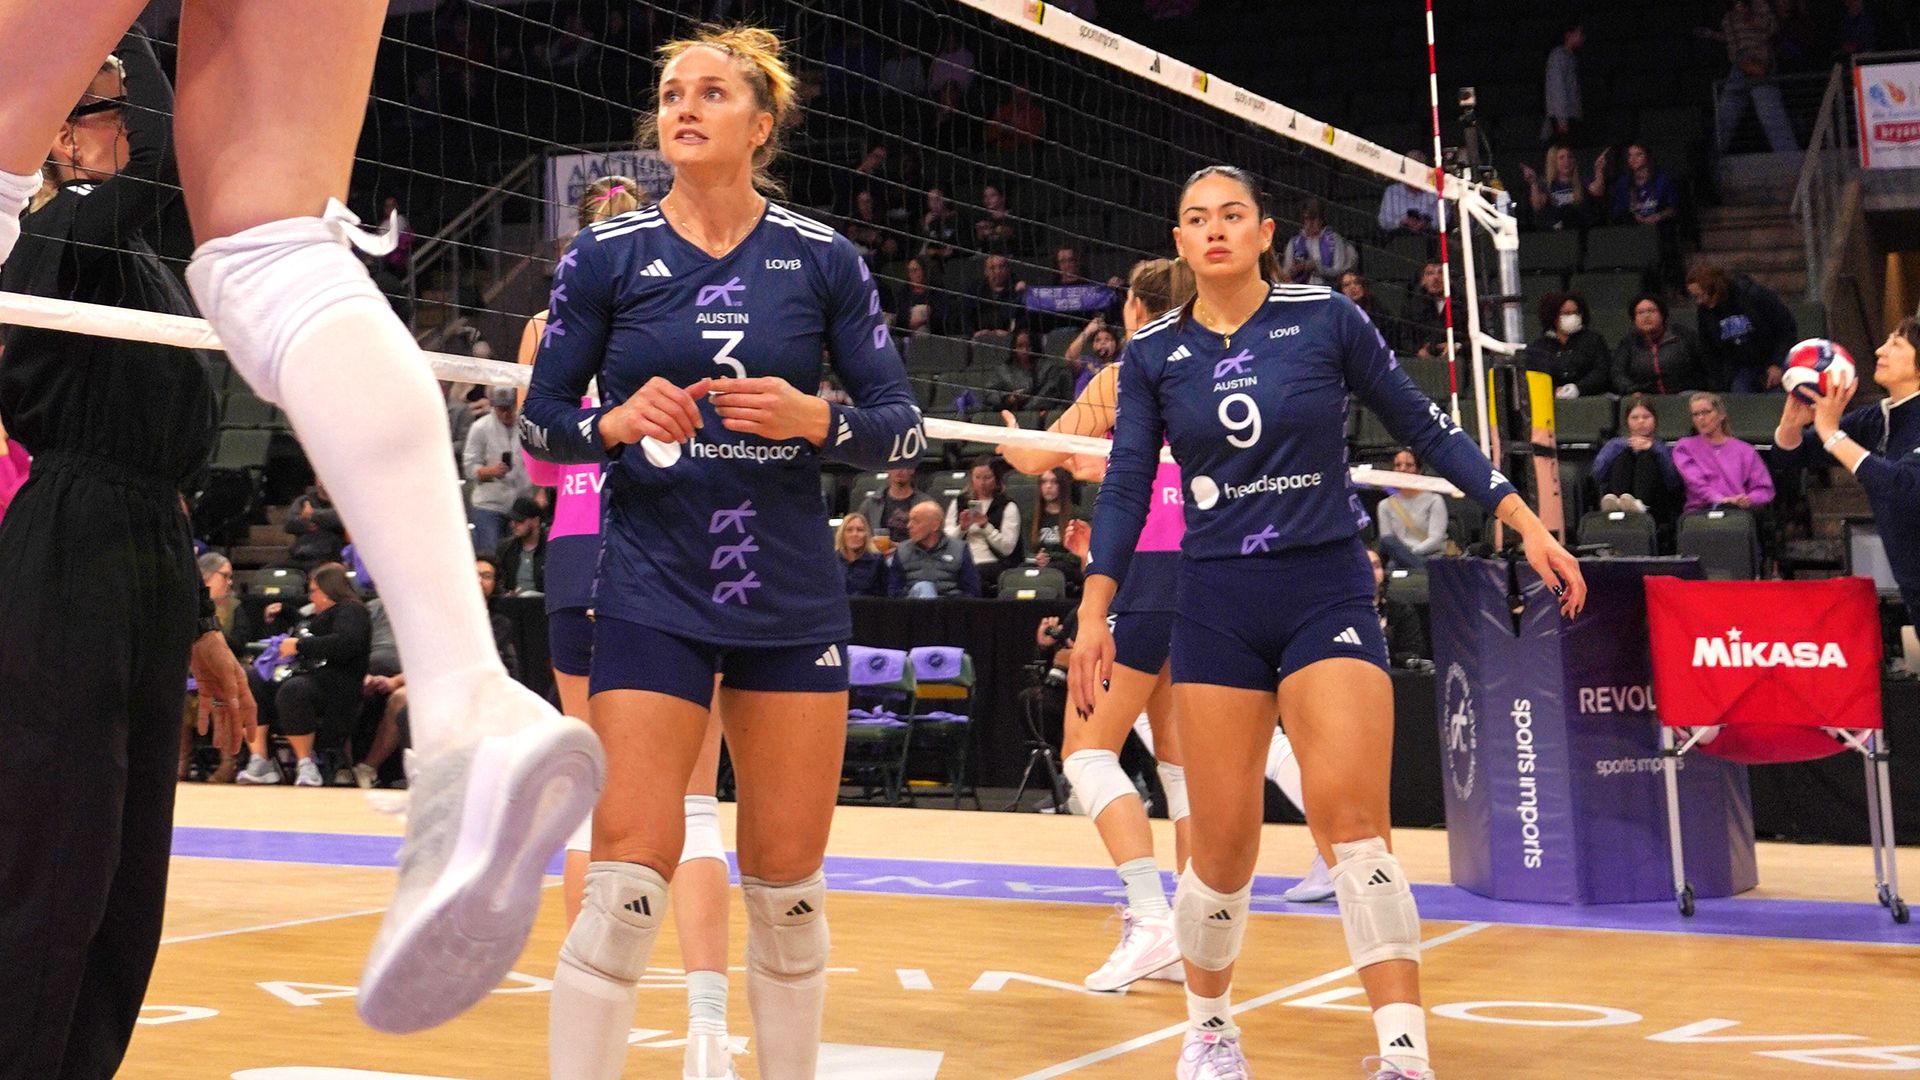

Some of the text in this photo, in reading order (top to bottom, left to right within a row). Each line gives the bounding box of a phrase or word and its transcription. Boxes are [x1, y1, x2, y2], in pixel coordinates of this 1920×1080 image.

[765, 259, 801, 270] LOVB
[695, 312, 749, 324] AUSTIN
[1269, 325, 1300, 339] LOVB
[702, 330, 747, 395] 3
[1213, 376, 1258, 392] AUSTIN
[1218, 393, 1262, 449] 9
[690, 437, 801, 464] headspac
[888, 422, 928, 462] LOV
[561, 472, 607, 496] REV
[1224, 472, 1322, 499] headspace
[1578, 685, 1657, 714] REVOL
[1510, 698, 1543, 869] sports imports
